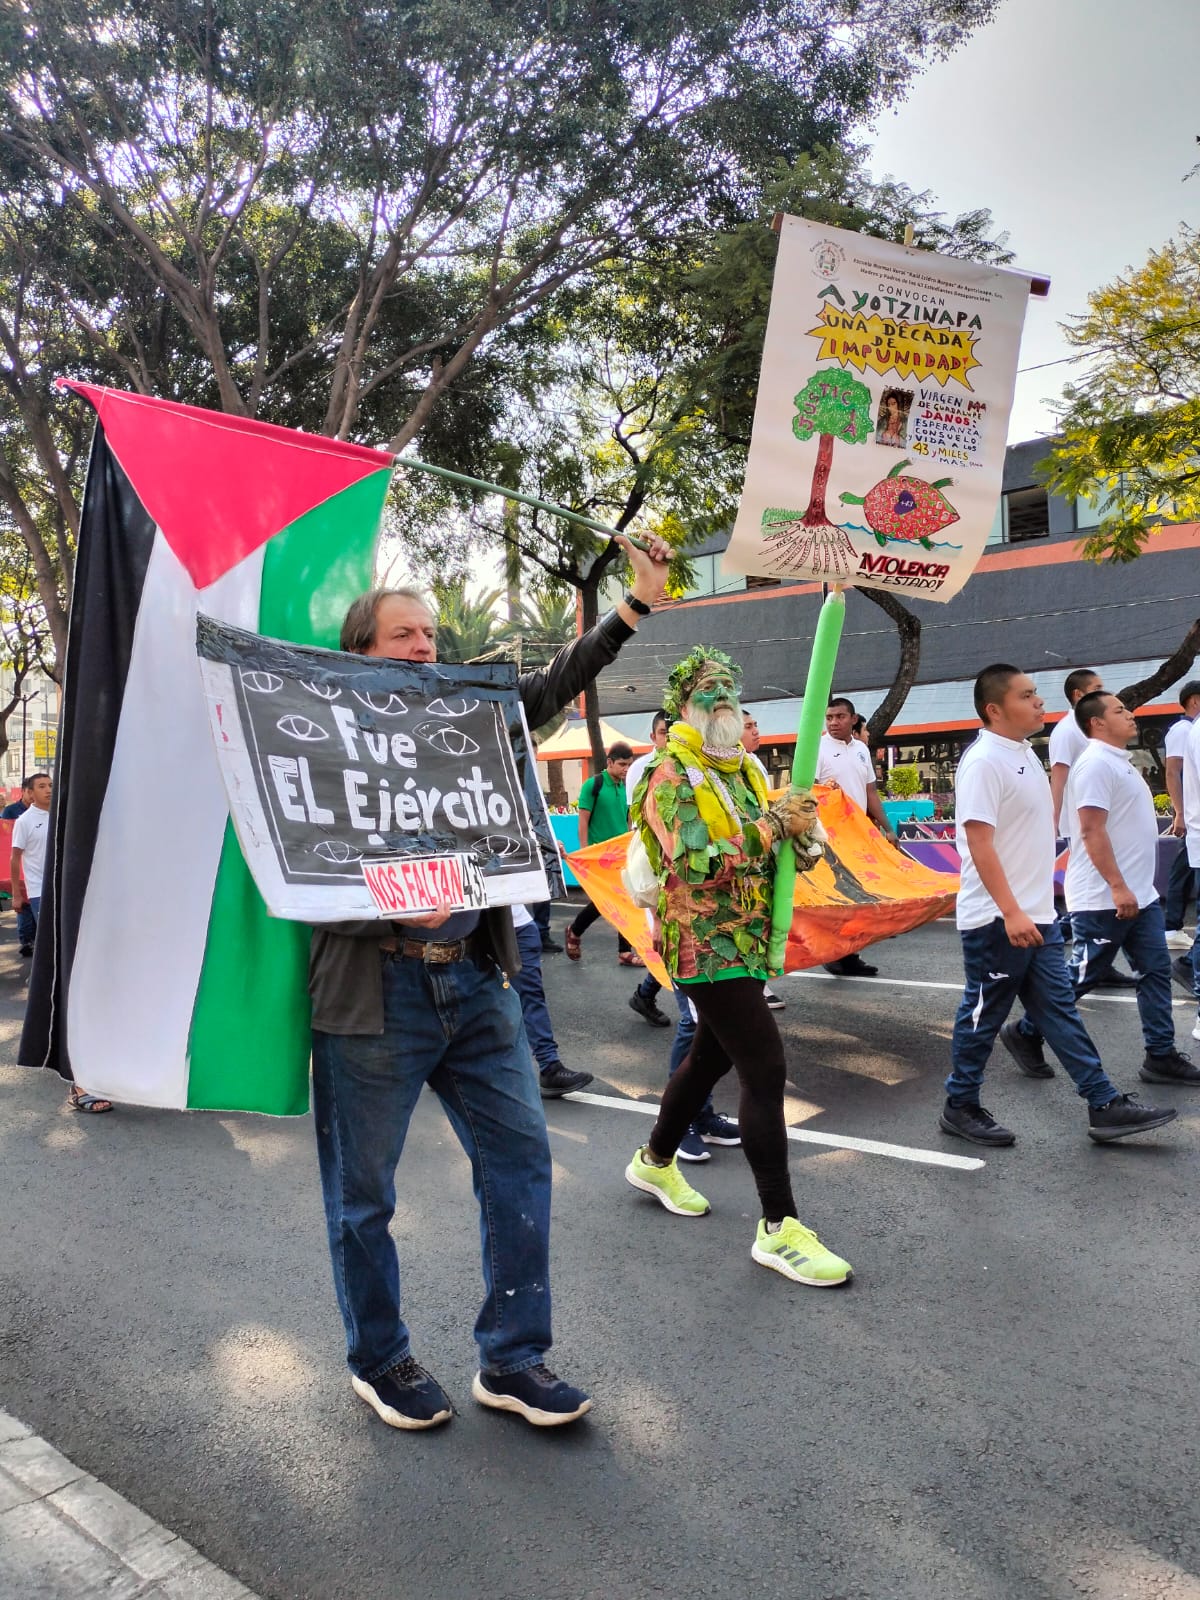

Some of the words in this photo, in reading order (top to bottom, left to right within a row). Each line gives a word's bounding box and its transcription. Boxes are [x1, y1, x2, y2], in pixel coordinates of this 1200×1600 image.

[878, 283, 945, 306] CONVOCAN
[817, 283, 983, 331] AYOTZINAPA
[871, 335, 896, 349] DE
[830, 339, 969, 370] IMPUNIDAD!
[917, 400, 932, 409] DE
[920, 388, 963, 408] VIRGEN
[913, 442, 929, 456] 43
[938, 447, 969, 461] MILES
[915, 434, 946, 446] VIDA
[330, 704, 418, 769] Fue
[343, 766, 512, 845] Ejército
[364, 864, 407, 911] NOS
[401, 859, 464, 908] FALTAN
